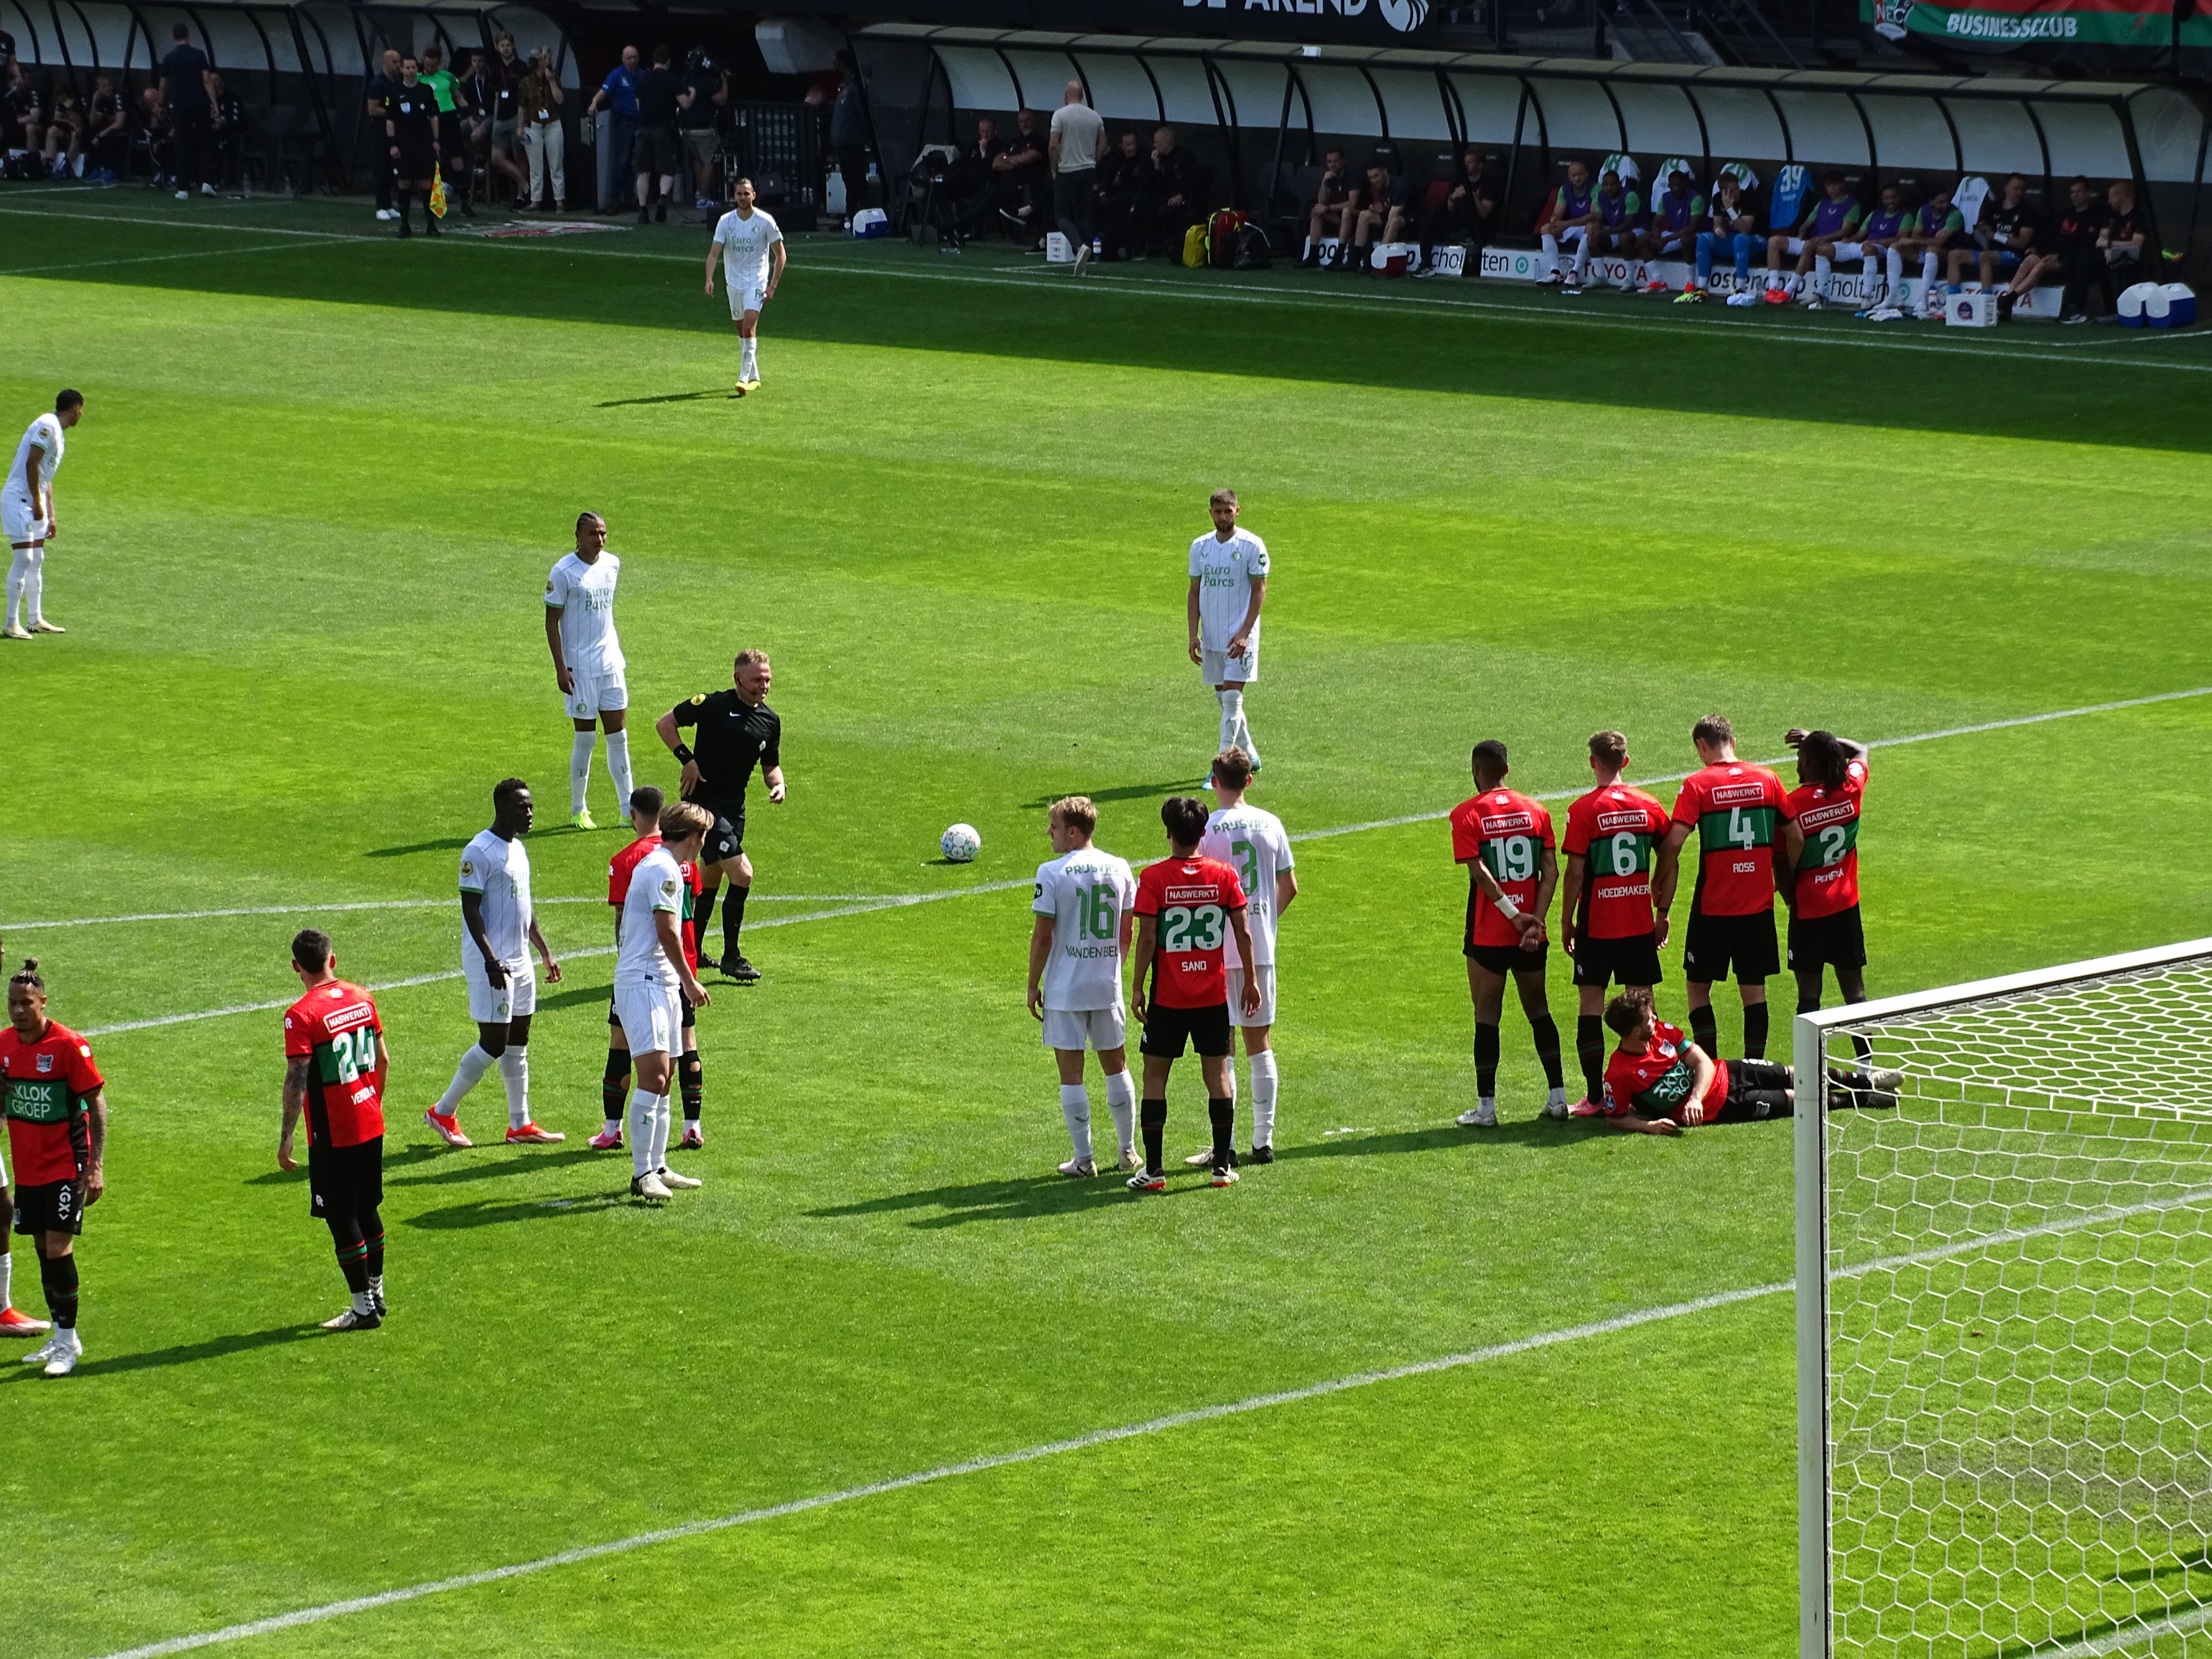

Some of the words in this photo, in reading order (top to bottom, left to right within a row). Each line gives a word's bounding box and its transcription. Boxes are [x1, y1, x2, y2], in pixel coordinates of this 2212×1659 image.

[1946, 14, 2077, 38] BUSINESSCLUB
[1204, 564, 1230, 575] Euro
[1204, 577, 1234, 588] Parcs
[586, 587, 609, 598] Euro
[585, 599, 611, 611] Parcs
[1716, 787, 1760, 800] NASWERKT
[1601, 814, 1645, 826] NASWERKT
[1804, 804, 1851, 824] NASWERKT
[1486, 816, 1529, 830] NASWERKT
[1729, 806, 1755, 850] 4
[1612, 831, 1637, 877] 6
[1820, 825, 1846, 867] 2
[1490, 835, 1533, 883] 19
[1733, 862, 1755, 873] ROSS
[1232, 840, 1259, 896] 3
[1169, 889, 1215, 900] NASWERKT
[1075, 883, 1117, 941] 16
[1165, 904, 1224, 953] 23
[1181, 960, 1207, 972] SANO
[332, 1025, 377, 1085] 24
[14, 1085, 52, 1101] KLOK
[12, 1099, 50, 1118] GROEP
